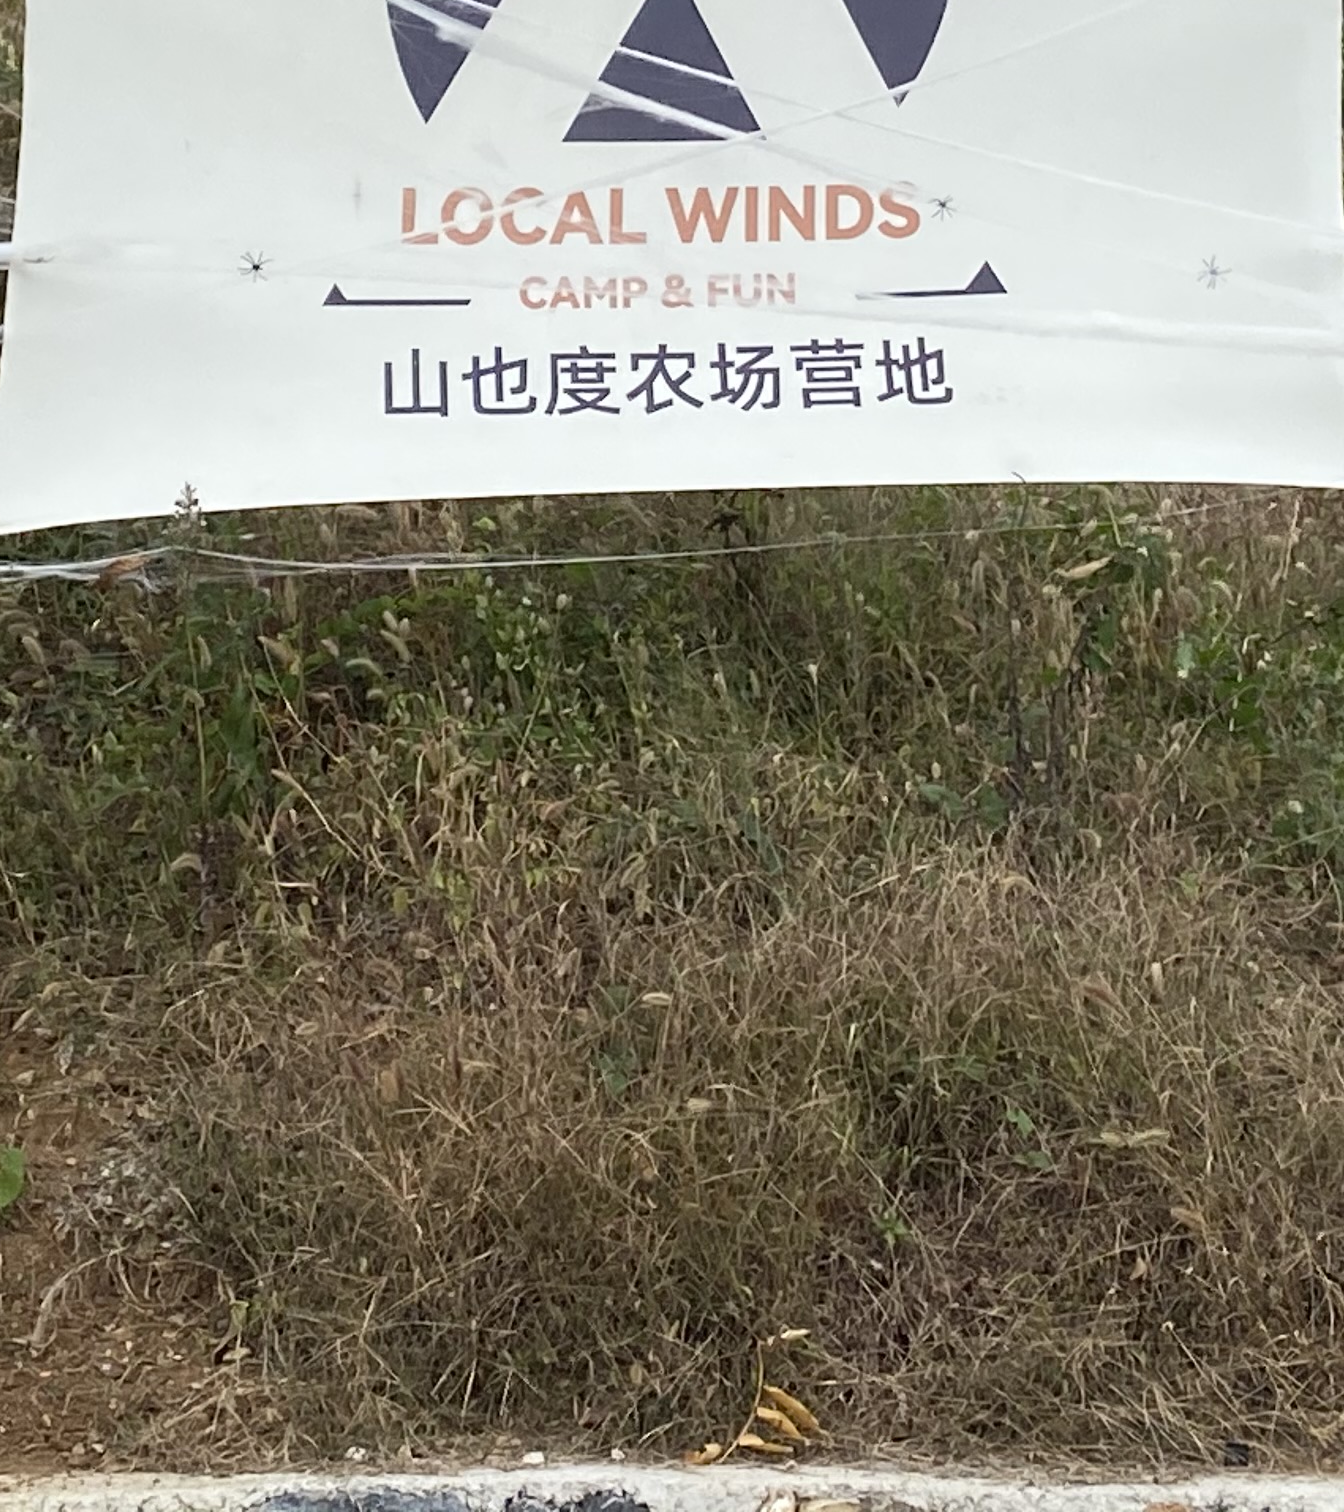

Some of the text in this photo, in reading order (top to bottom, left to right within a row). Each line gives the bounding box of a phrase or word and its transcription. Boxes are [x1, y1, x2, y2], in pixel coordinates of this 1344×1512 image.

[401, 183, 922, 245] LOCAL WINDS
[519, 272, 797, 310] CAMP & FUN
[383, 337, 954, 417] 山也度农场营地
